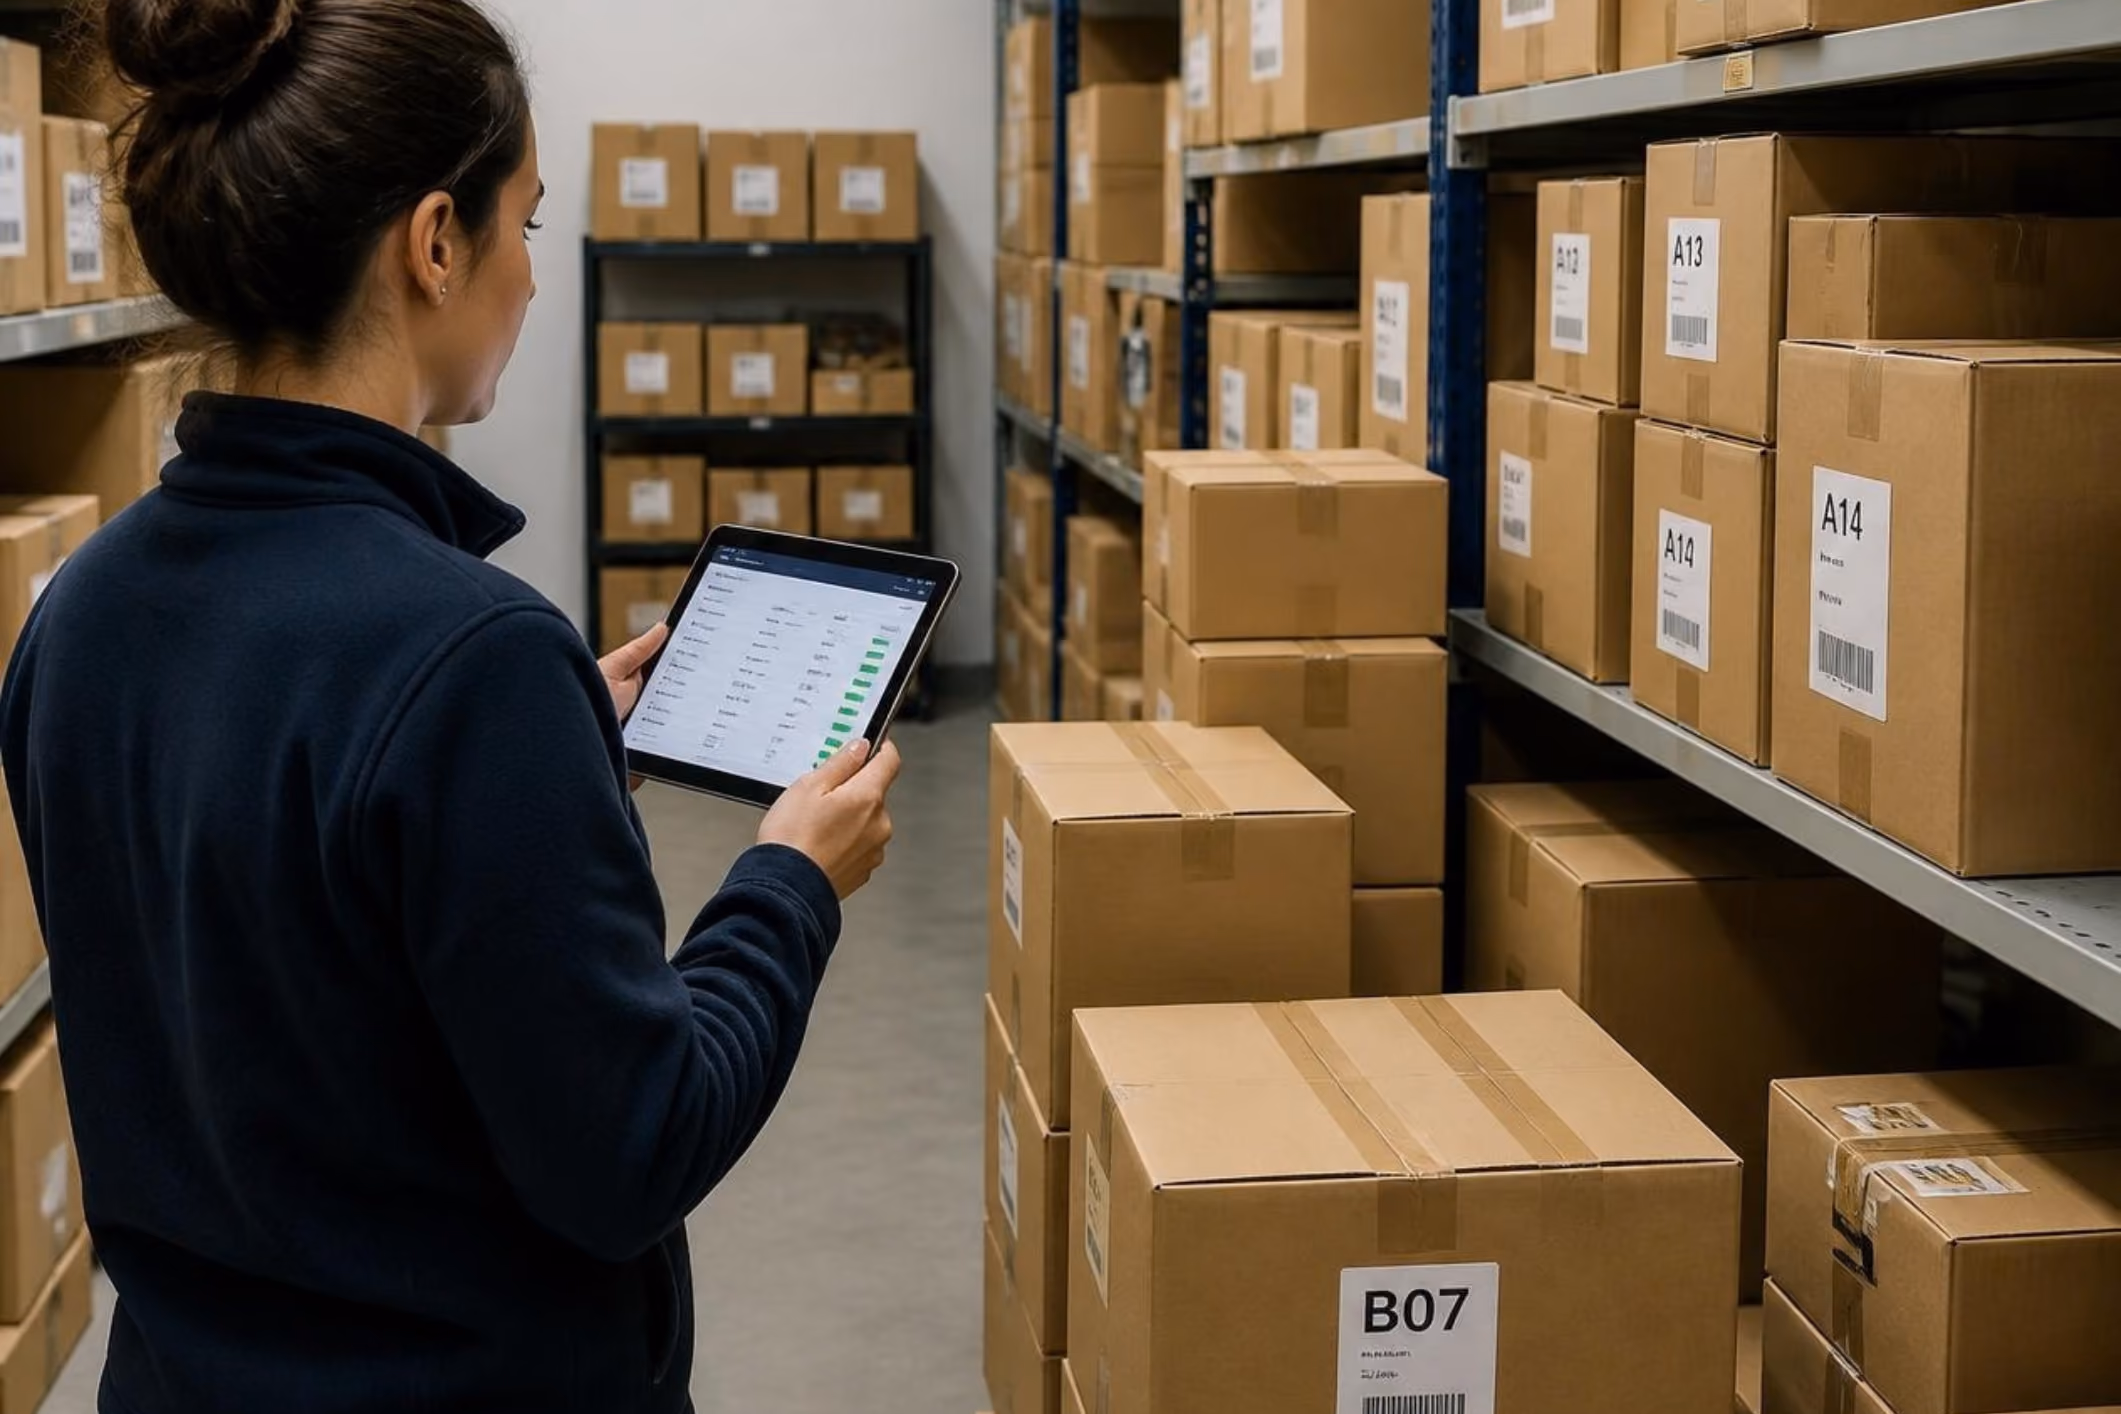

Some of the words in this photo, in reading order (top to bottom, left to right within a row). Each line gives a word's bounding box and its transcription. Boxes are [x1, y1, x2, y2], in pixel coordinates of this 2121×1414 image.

[1672, 234, 1704, 268] A13
[1821, 492, 1863, 541] A14
[1664, 528, 1695, 569] A14
[1364, 1288, 1470, 1333] B07
